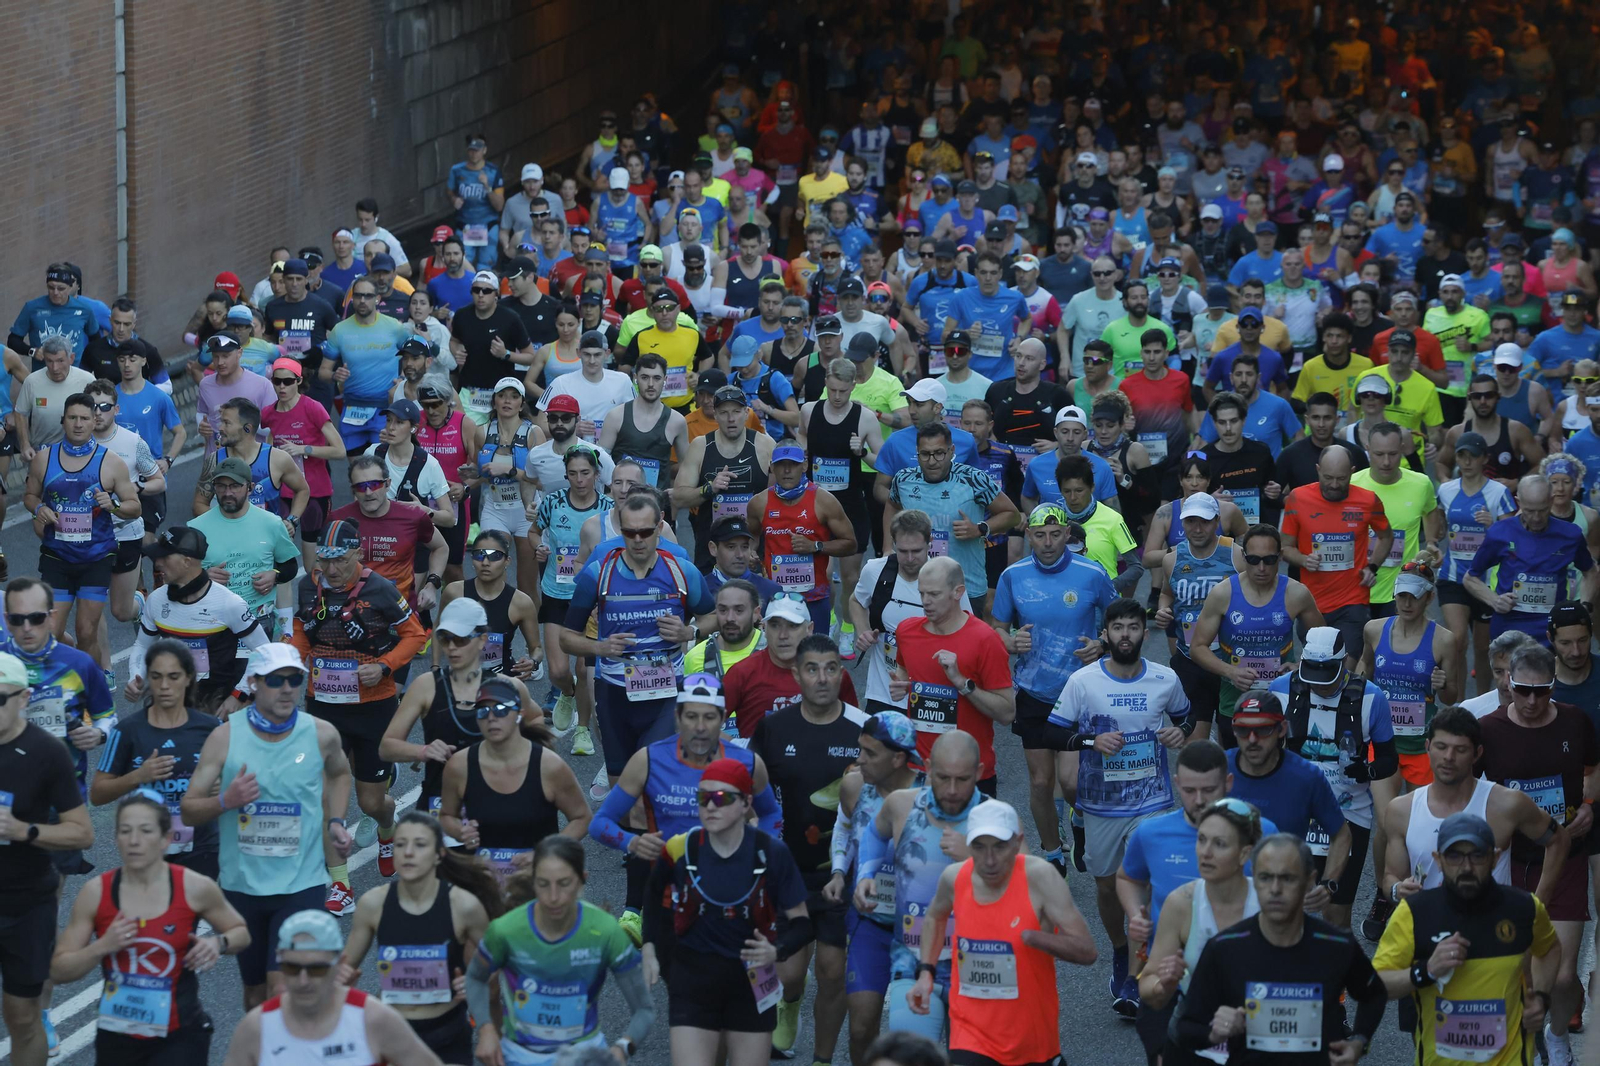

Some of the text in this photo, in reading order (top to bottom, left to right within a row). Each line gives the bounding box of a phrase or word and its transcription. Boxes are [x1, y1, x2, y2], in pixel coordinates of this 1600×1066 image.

[291, 319, 315, 332] NANE
[422, 446, 458, 455] ANCHATHON
[1014, 446, 1036, 454] ZURICH
[817, 474, 845, 483] TRISTAN
[502, 493, 519, 503] NINE
[1232, 489, 1255, 497] ZURICH
[765, 526, 815, 536] Puerto Rico
[1326, 534, 1351, 542] ZURICH
[373, 550, 397, 558] maratón
[785, 555, 809, 564] ZURICH
[1323, 553, 1345, 563] TUTU
[775, 573, 811, 585] ALFREDO
[1522, 594, 1547, 604] OGGIE
[619, 608, 673, 621] MARMANDE
[1231, 633, 1285, 643] MONTEMAR
[1248, 650, 1275, 658] ZURICH
[325, 661, 352, 669] ZURICH
[312, 681, 359, 693] CASASAYAS
[631, 676, 672, 690] PHILIPPE
[924, 685, 953, 697] ZURICH
[1110, 697, 1148, 707] JEREZ
[1391, 692, 1420, 702] ZURICH
[916, 708, 946, 724] DAVID
[1389, 715, 1415, 726] AULA
[1121, 749, 1138, 758] 6825
[1103, 756, 1157, 771] JOSÉ MARÍA
[140, 779, 191, 793] MADR
[1523, 779, 1556, 791] ZURICH
[655, 793, 688, 807] JOSEP
[259, 804, 295, 815] ZURICH
[256, 836, 300, 846] FERNANDO
[971, 942, 1008, 953] ZURICH
[399, 948, 440, 960] ZURICH
[125, 976, 166, 990] ZURICH
[390, 976, 439, 990] MERLIN
[968, 971, 1002, 985] JORDI
[539, 983, 580, 997] ZURICH
[1271, 986, 1314, 998] ZURICH
[1457, 1003, 1498, 1014] ZURICH
[536, 1013, 563, 1027] EVA
[1268, 1020, 1299, 1034] GRH
[1444, 1032, 1496, 1048] JUANJO
